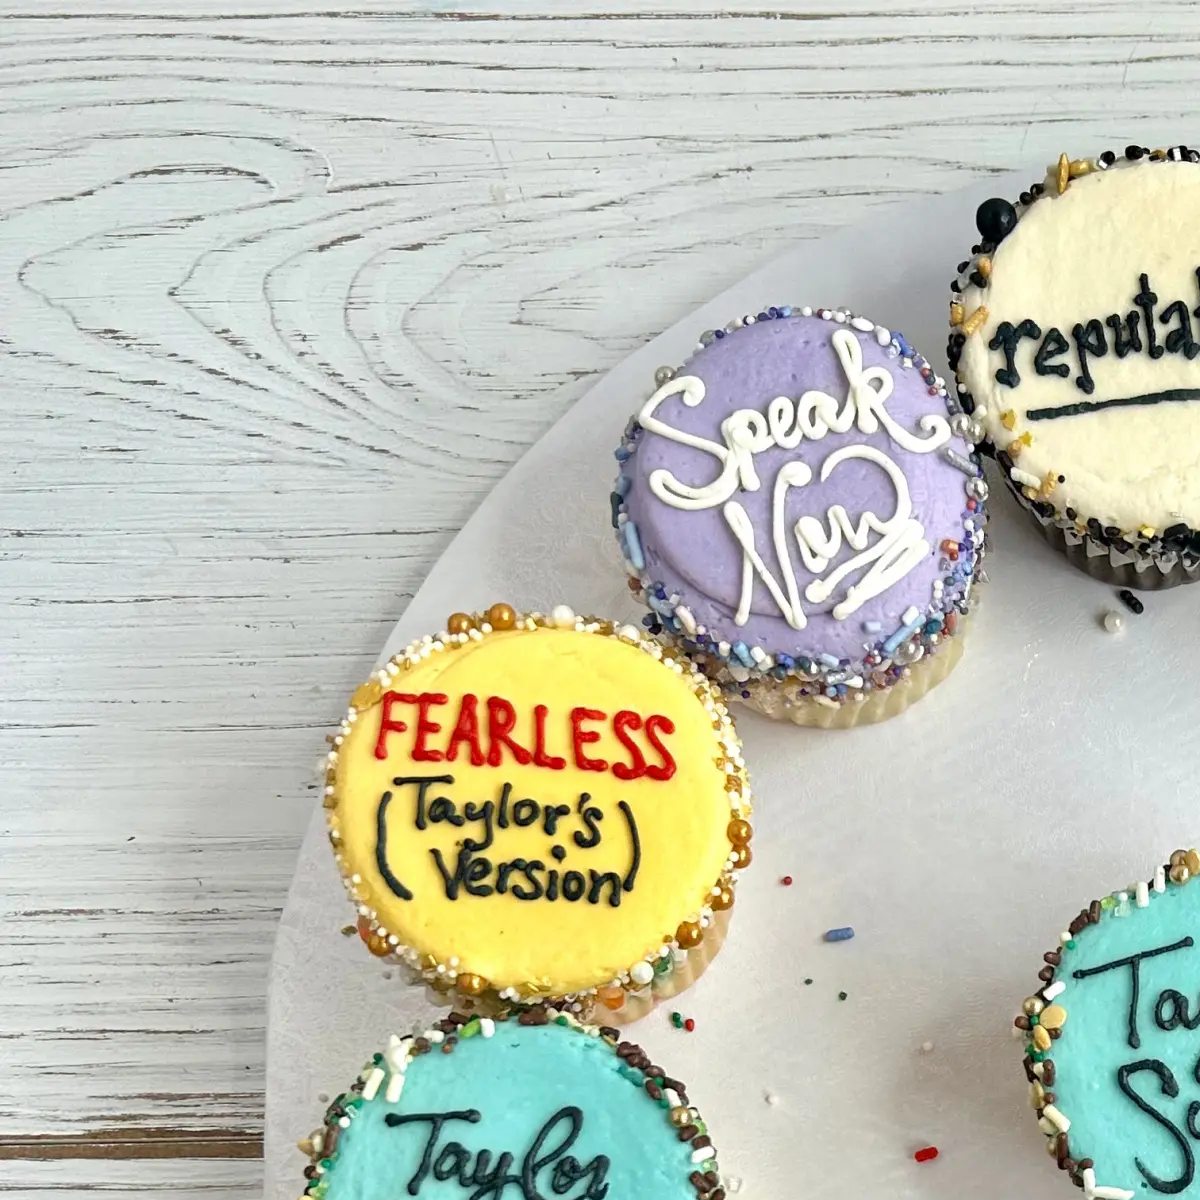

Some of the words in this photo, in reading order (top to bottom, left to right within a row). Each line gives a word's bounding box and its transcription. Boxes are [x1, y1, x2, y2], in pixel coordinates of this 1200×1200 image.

[637, 328, 951, 509] Speak
[724, 442, 911, 630] Now
[375, 692, 676, 782] FEARLESS
